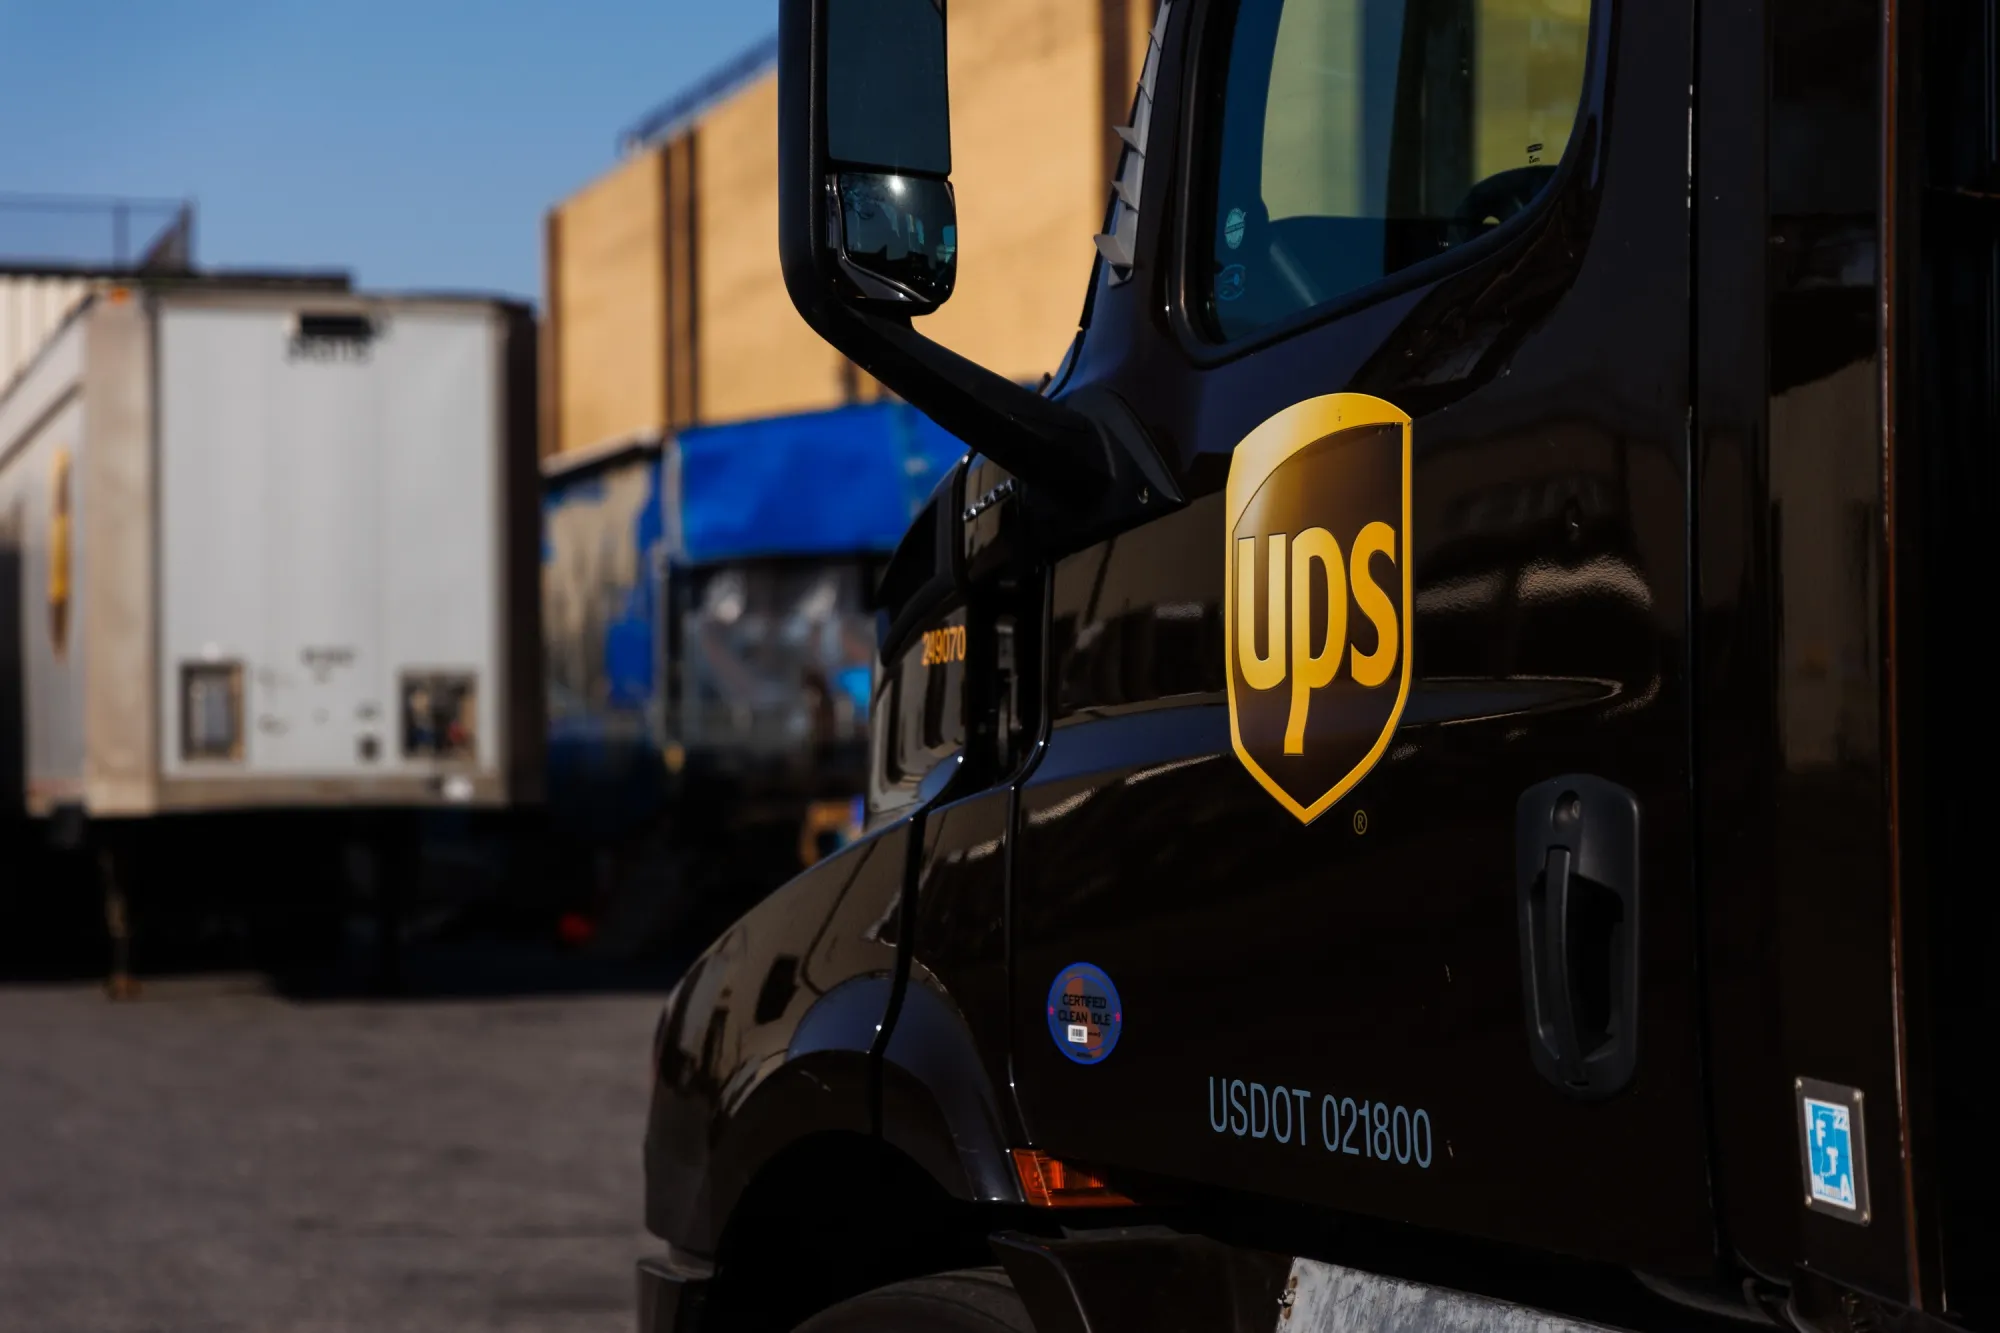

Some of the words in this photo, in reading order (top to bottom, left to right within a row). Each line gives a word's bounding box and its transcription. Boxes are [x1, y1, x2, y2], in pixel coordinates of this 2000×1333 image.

[921, 625, 966, 666] 249070
[1062, 994, 1107, 1009] CERTIFIED
[1058, 1009, 1088, 1023] CLEAN
[1091, 1012, 1111, 1026] IDLE
[1209, 1076, 1311, 1146] USDOT
[1321, 1094, 1432, 1168] 021800
